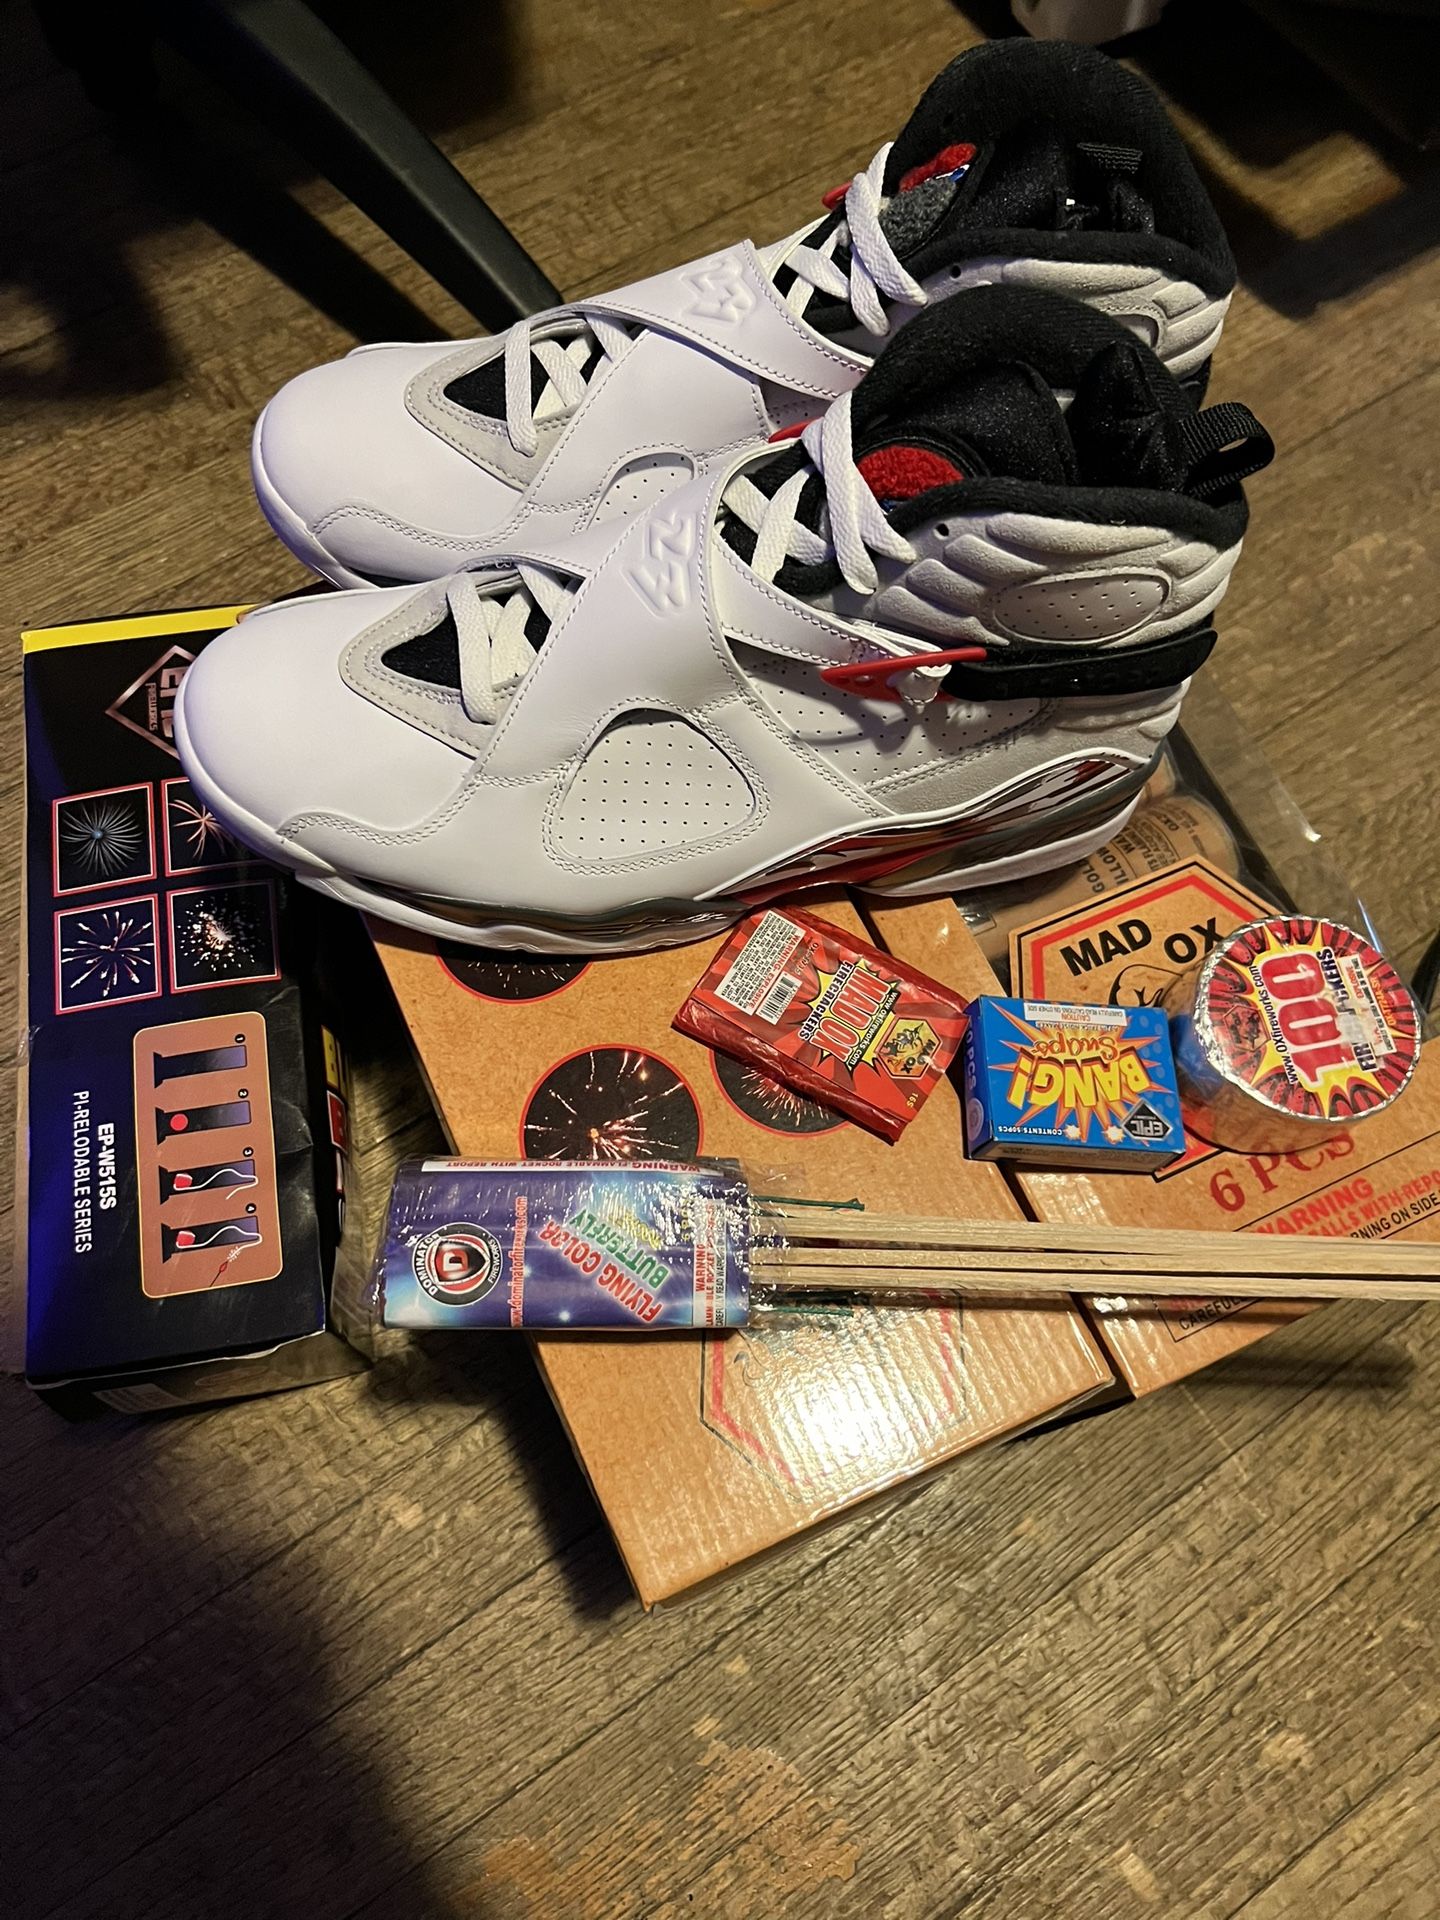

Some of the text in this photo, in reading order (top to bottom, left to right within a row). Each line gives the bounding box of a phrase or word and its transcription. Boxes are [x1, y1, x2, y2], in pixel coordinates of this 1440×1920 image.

[1060, 917, 1225, 976] MAD OX
[747, 971, 775, 1009] EXPLOSIVE
[797, 959, 854, 1041] FIRECRACKERS
[808, 966, 891, 1063] MAD OX
[1060, 1012, 1090, 1022] CAUTION
[1261, 953, 1355, 1084] 100
[900, 1054, 917, 1075] OX
[1034, 1032, 1119, 1060] Snaps
[904, 1091, 919, 1108] 16S
[1007, 1048, 1152, 1109] BANG!
[1129, 1119, 1164, 1136] EPIC
[72, 1090, 92, 1253] PI-RELODABLE SERIES
[96, 1122, 117, 1210] EP-W515S
[631, 1160, 700, 1173] WARNING
[1208, 1128, 1355, 1213] 6 PCS
[1255, 1177, 1374, 1235] WARNING
[1351, 1191, 1440, 1240] RNING ON SIDE
[415, 1232, 441, 1297] DOMINATOR
[440, 1249, 468, 1274] D
[487, 1236, 502, 1284] FIREWORKS
[537, 1219, 663, 1323] FLYING COLOR
[568, 1207, 669, 1289] BUTTERFLY
[694, 1243, 705, 1291] WARNING
[714, 1277, 724, 1293] READ
